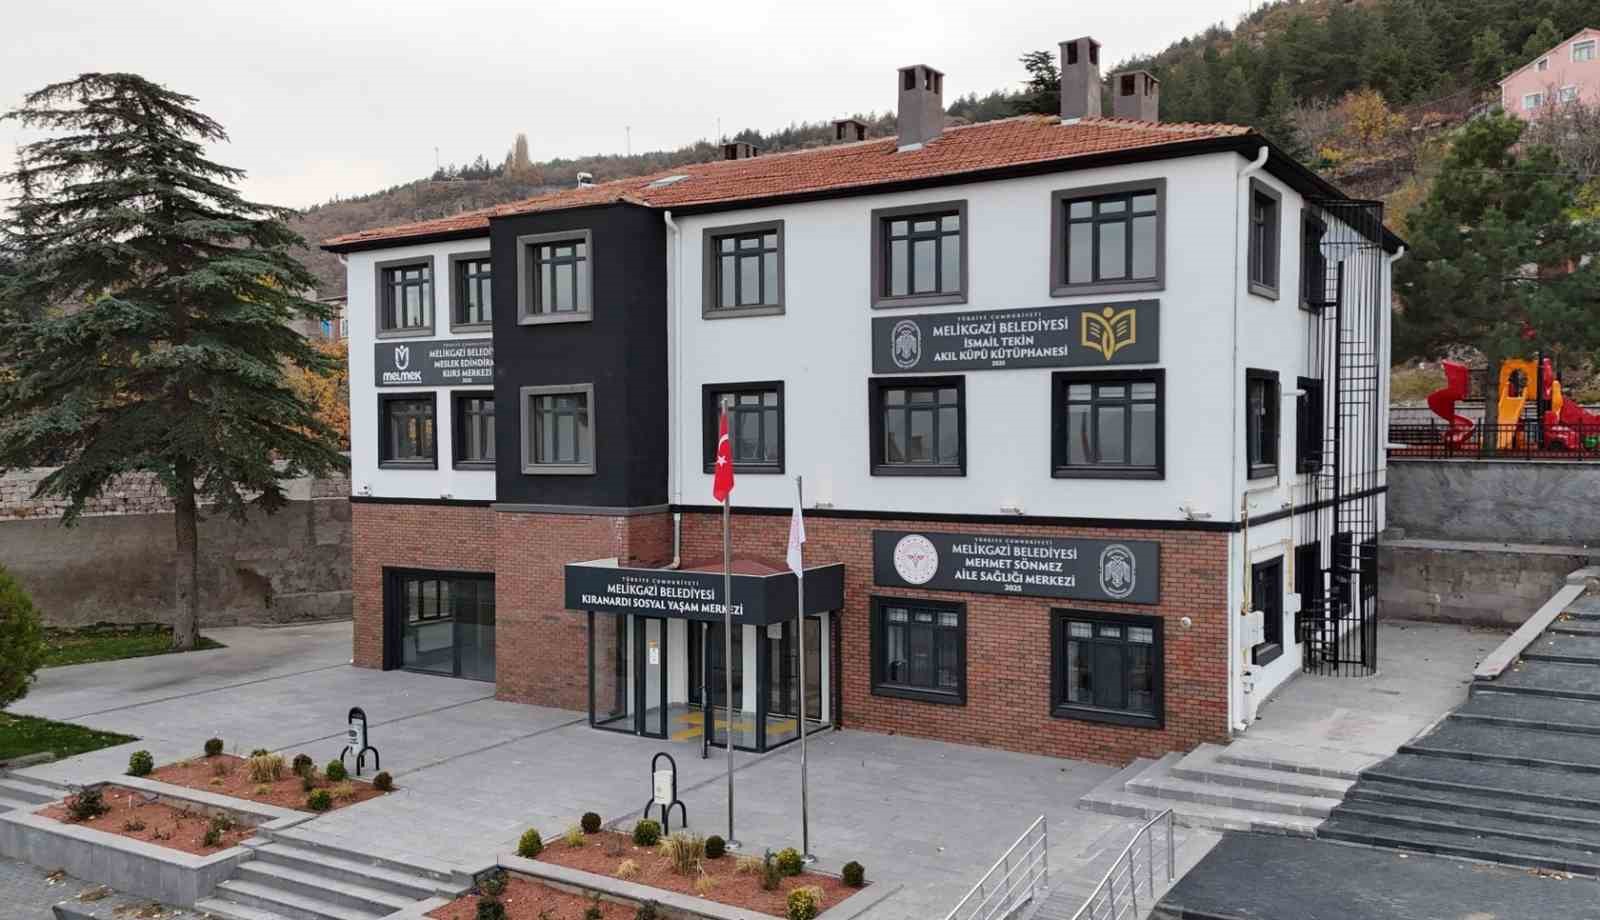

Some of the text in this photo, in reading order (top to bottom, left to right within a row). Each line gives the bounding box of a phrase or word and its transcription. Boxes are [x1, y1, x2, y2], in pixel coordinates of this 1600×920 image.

[933, 316, 1068, 336] MELİKGAZİ BELEDİYESİ
[964, 334, 1034, 348] İSMAİL TEKİN
[429, 348, 466, 357] MELİKGAZİ
[934, 345, 1068, 361] AKIL KÜPÜ KÜTÜPHANESİ
[434, 359, 459, 368] MESLEK
[442, 368, 492, 377] KURS MERKEZİ
[952, 543, 1077, 560] MELİKGAZİ BELEDİYESİ
[965, 558, 1063, 572] MEHMET SÖNMEZ
[954, 568, 1076, 587] AİLE SAĞLIĞI MERKEZİ
[607, 583, 715, 600] MELİKGAZİ BELEDİYESİ
[582, 594, 631, 606] KIRANARDI
[633, 599, 666, 609] SOSYAL
[668, 602, 699, 613] YAŞAM
